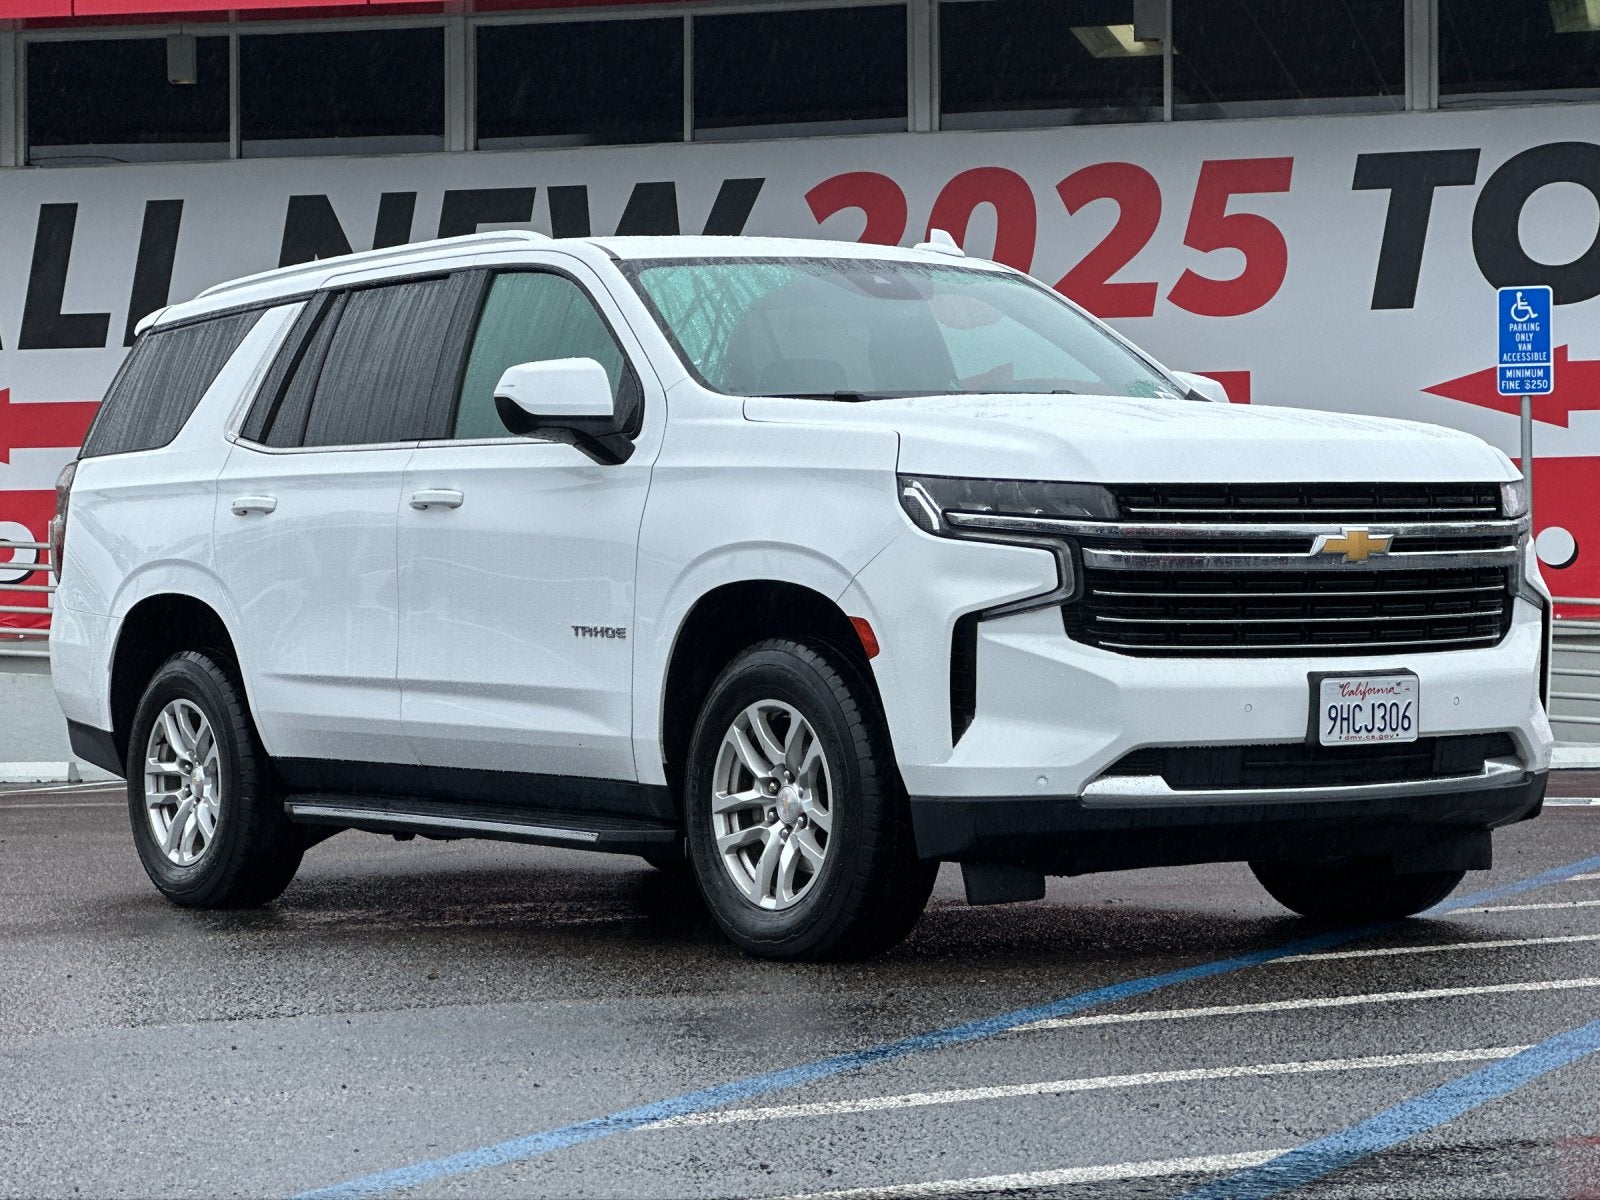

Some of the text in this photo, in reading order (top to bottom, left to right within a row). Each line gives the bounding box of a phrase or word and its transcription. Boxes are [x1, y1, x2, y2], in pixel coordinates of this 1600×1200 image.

[0, 199, 184, 350] LL
[1509, 322, 1540, 332] PARKING
[1515, 332, 1534, 342] ONLY
[1517, 342, 1532, 351] VAN
[1502, 352, 1547, 362] ACCESSIBLE
[1506, 368, 1544, 378] MINIMUM
[1501, 380, 1548, 390] FINE $250
[570, 625, 627, 639] TAHOE
[1341, 681, 1401, 701] California
[1327, 700, 1412, 735] 9HCJ306
[1344, 733, 1395, 741] dmv.ca.gov
